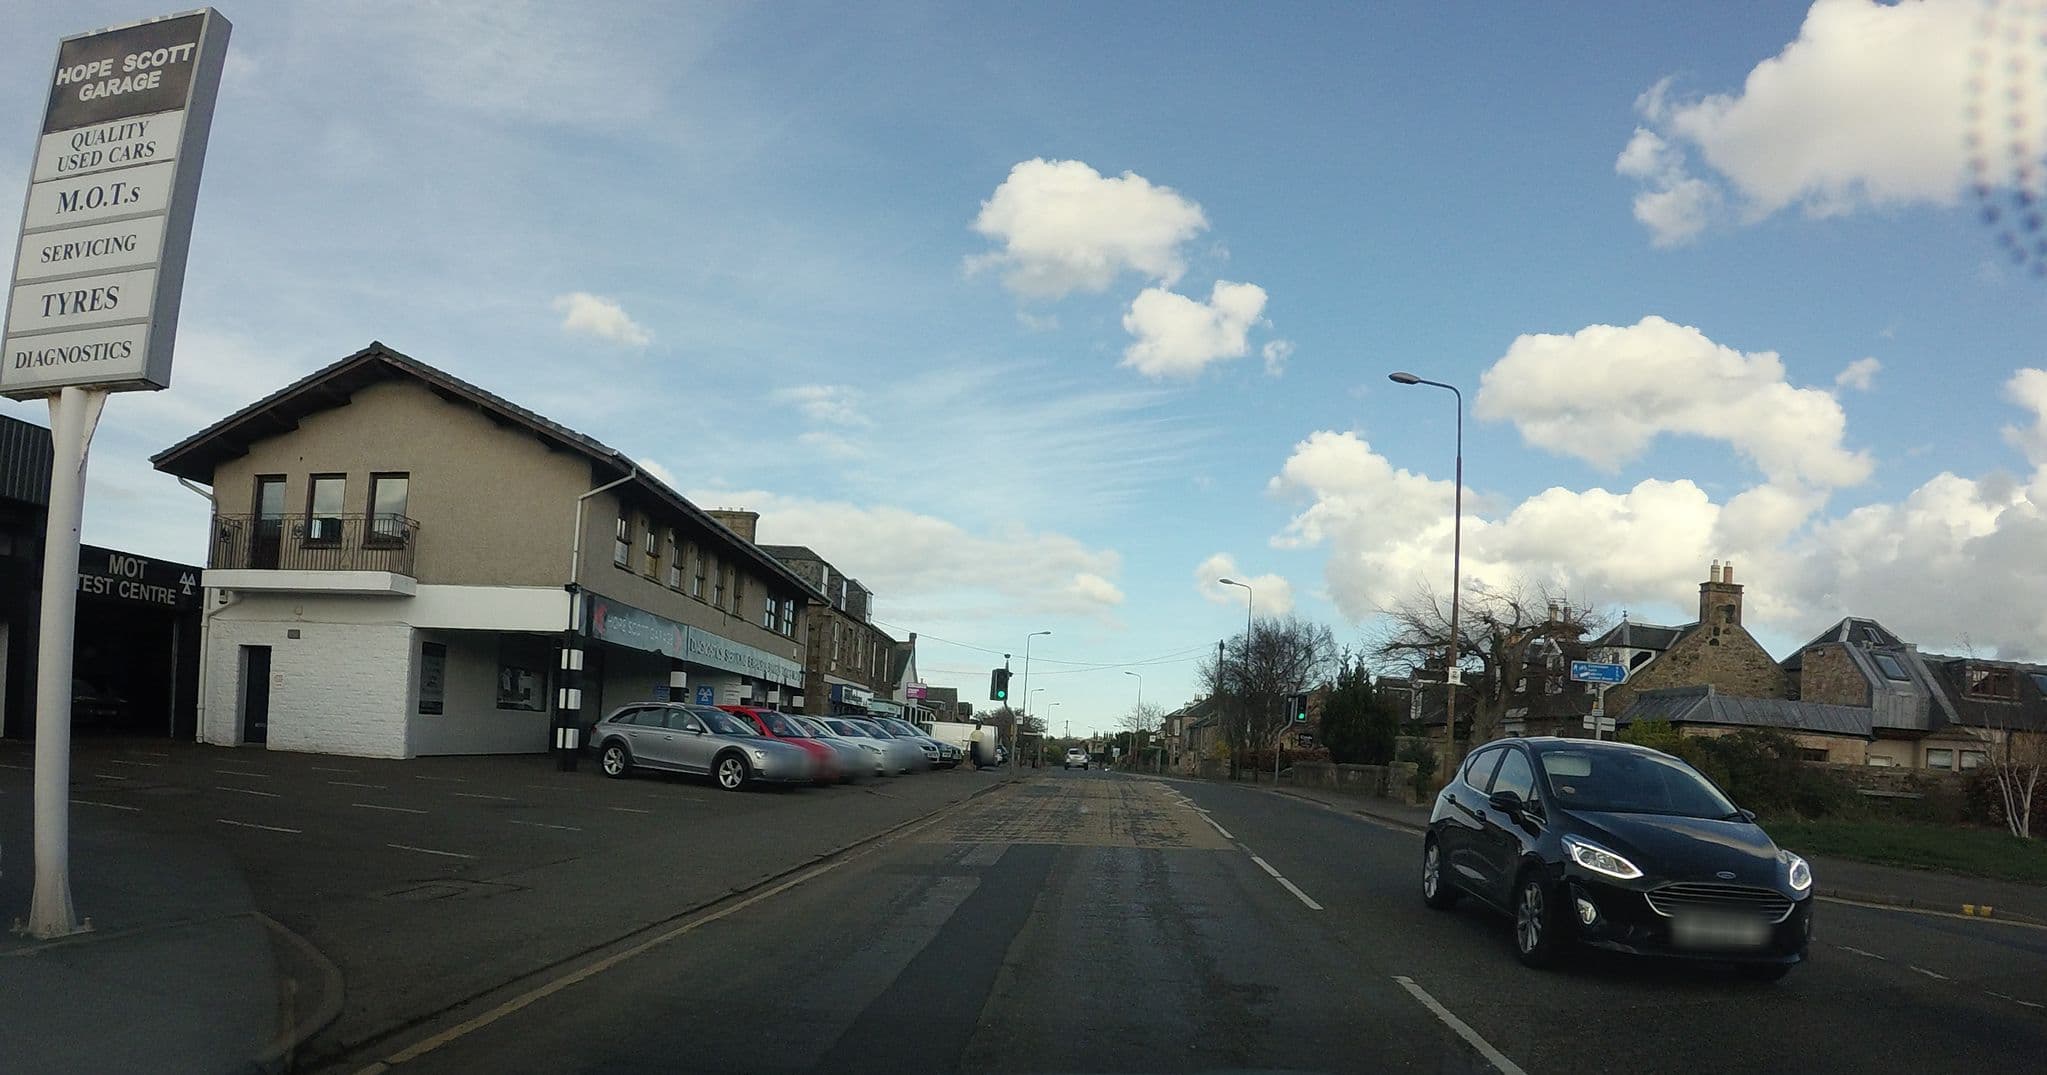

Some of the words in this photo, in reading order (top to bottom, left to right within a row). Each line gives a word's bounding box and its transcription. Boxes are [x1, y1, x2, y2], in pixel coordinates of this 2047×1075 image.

[56, 58, 114, 86] HOPE
[122, 42, 196, 73] SCOTT
[78, 70, 162, 102] GARAGE
[71, 121, 149, 151] QUALITY
[58, 150, 102, 173] USED
[108, 141, 156, 168] CARS
[55, 182, 141, 215] M.O.T.s
[41, 234, 137, 264] SERVICING
[41, 286, 120, 318] TYRES
[15, 340, 132, 370] DIAGNOSTICS
[108, 553, 148, 579] MOT
[118, 580, 177, 605] CENTRE
